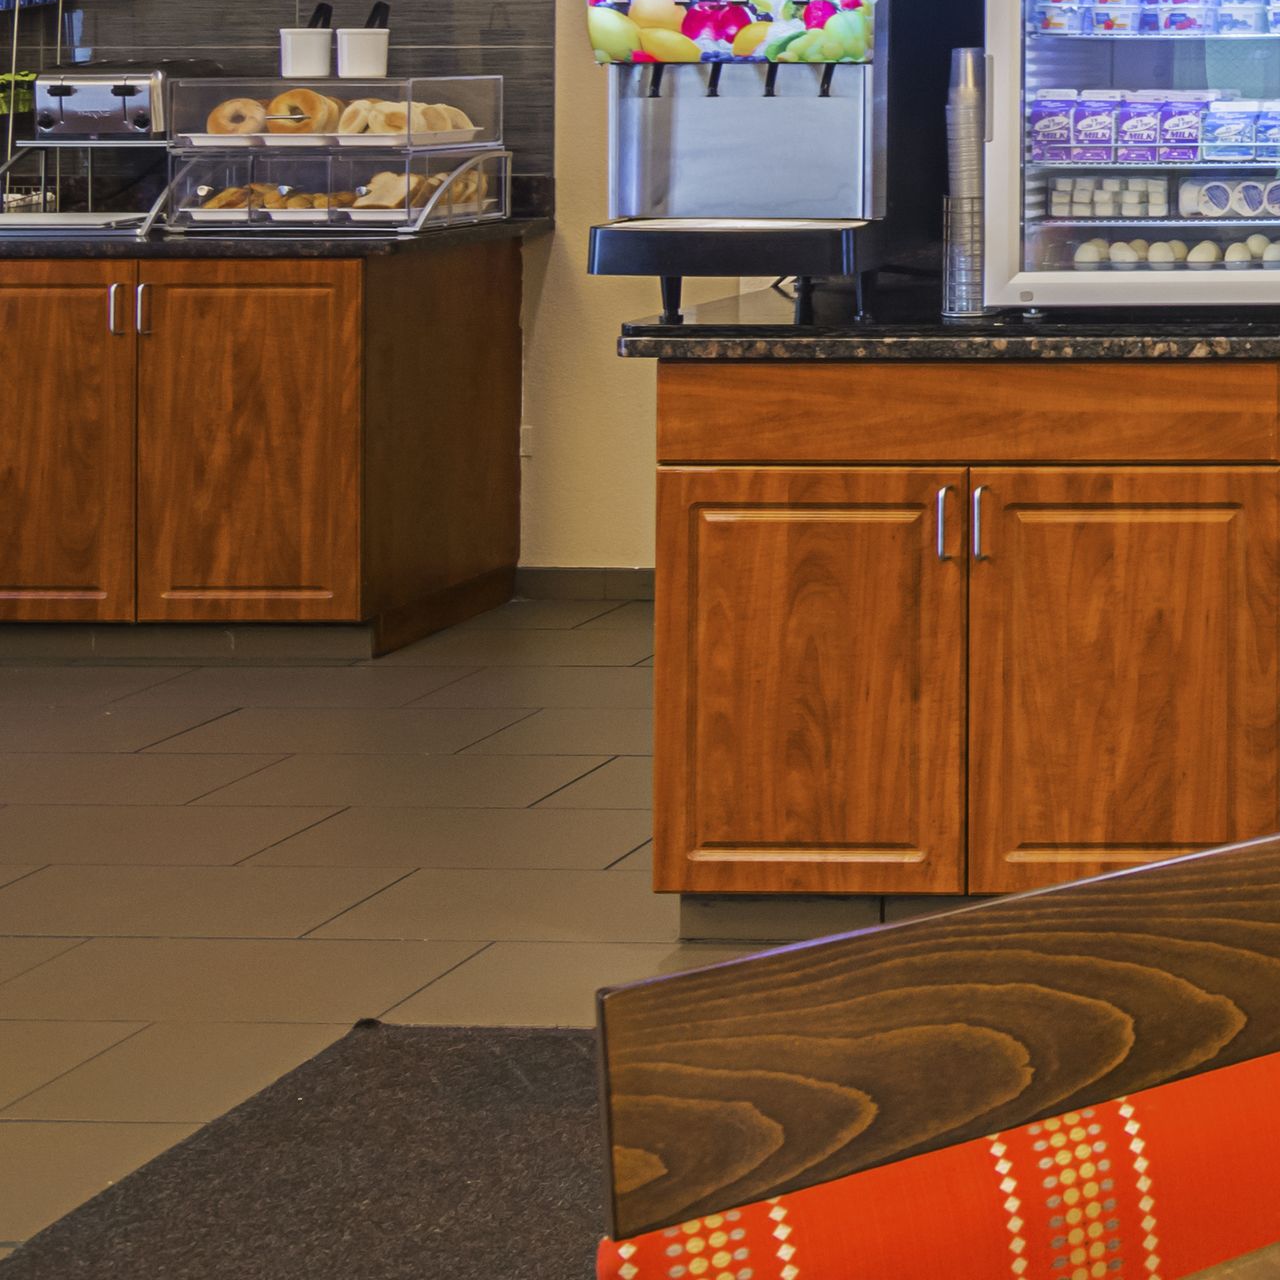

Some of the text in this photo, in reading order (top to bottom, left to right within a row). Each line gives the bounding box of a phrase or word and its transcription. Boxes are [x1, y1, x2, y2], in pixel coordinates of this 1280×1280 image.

[1041, 131, 1066, 139] MILK
[1083, 131, 1107, 139] MILK
[1129, 131, 1153, 140] MILK
[1170, 130, 1194, 139] MILK
